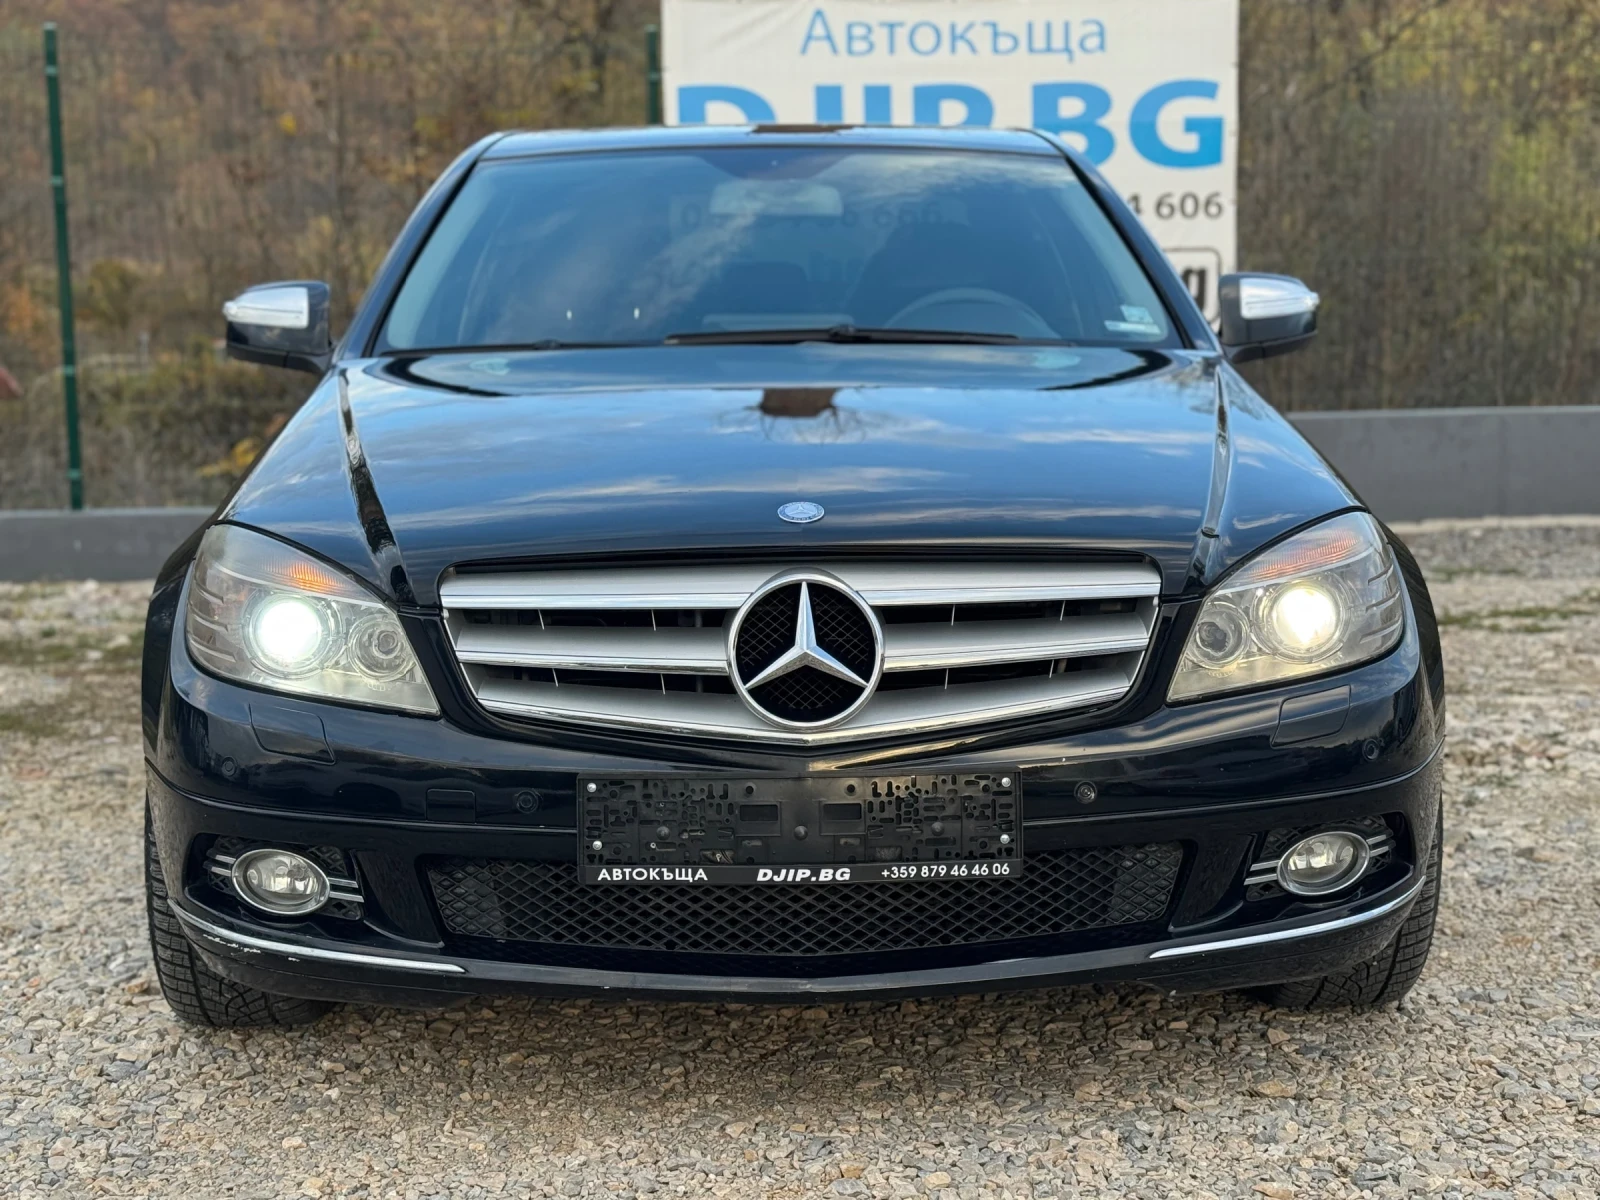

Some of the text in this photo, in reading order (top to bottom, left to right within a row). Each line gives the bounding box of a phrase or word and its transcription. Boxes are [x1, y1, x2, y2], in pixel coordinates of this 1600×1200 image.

[799, 8, 1107, 63] Автокъща
[1155, 191, 1223, 219] 606
[598, 867, 708, 882] АВТОКЪЩА
[756, 867, 851, 881] DJIP.BG
[881, 863, 1010, 878] +359 879 46 46 06
